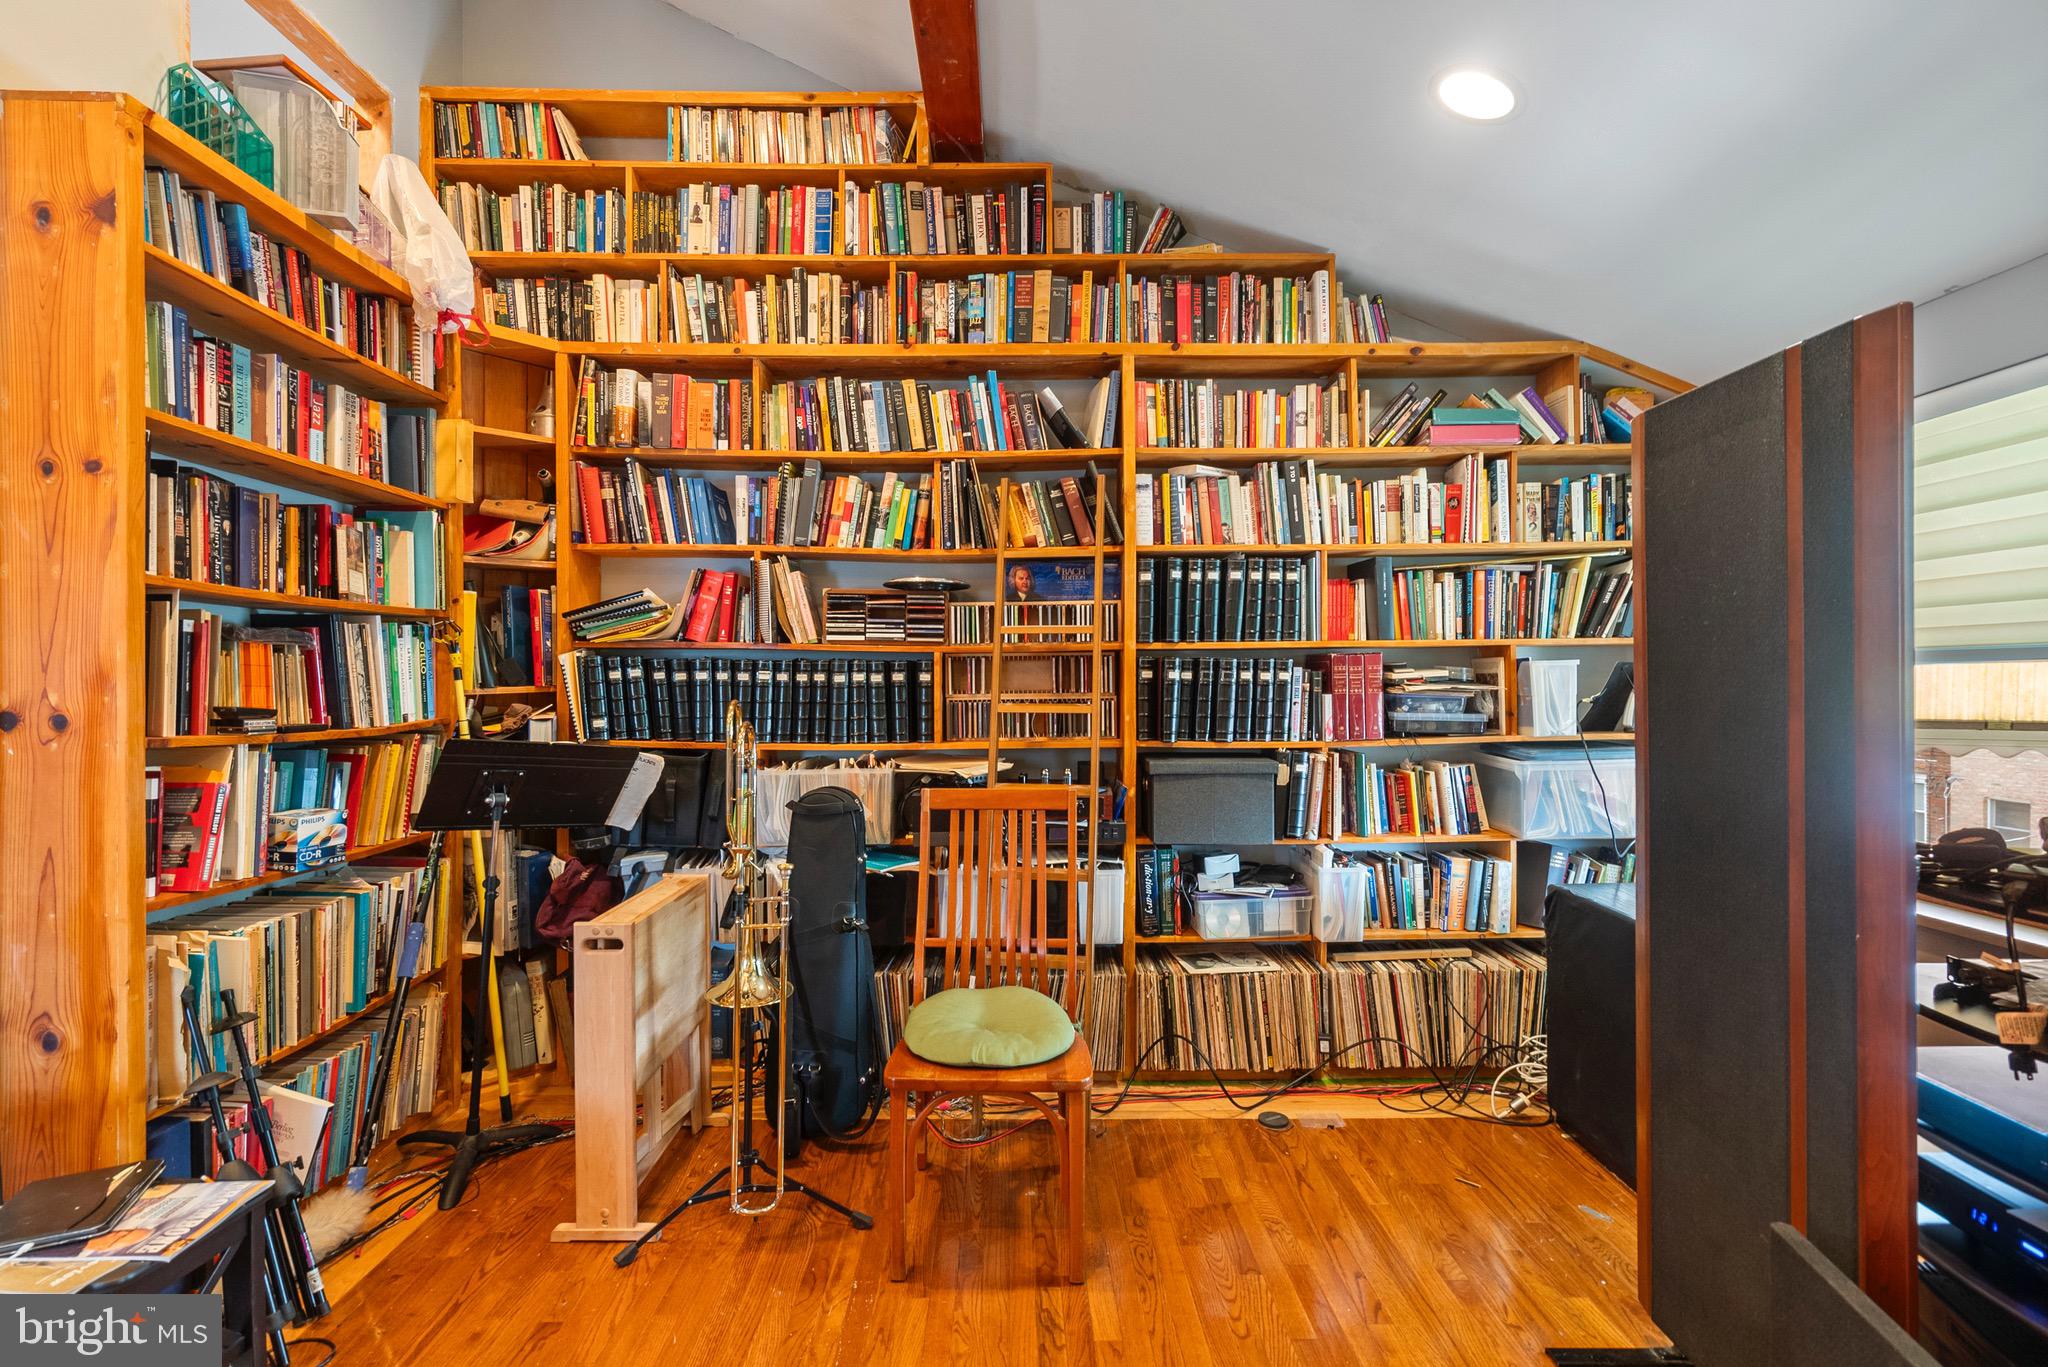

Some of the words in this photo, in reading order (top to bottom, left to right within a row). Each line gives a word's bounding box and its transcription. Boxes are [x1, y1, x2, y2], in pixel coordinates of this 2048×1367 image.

[288, 370, 297, 404] LISZT
[741, 384, 749, 410] MOZART
[311, 399, 322, 425] Jazz
[1008, 404, 1018, 427] BACH
[1024, 404, 1035, 426] BACH
[851, 411, 860, 443] STANDARDS
[213, 515, 221, 548] History
[215, 794, 224, 813] LEHMAN
[212, 814, 221, 834] TRILOGY
[301, 816, 325, 825] PHILIPS
[300, 850, 322, 861] CD-R
[1456, 879, 1465, 919] Spanish
